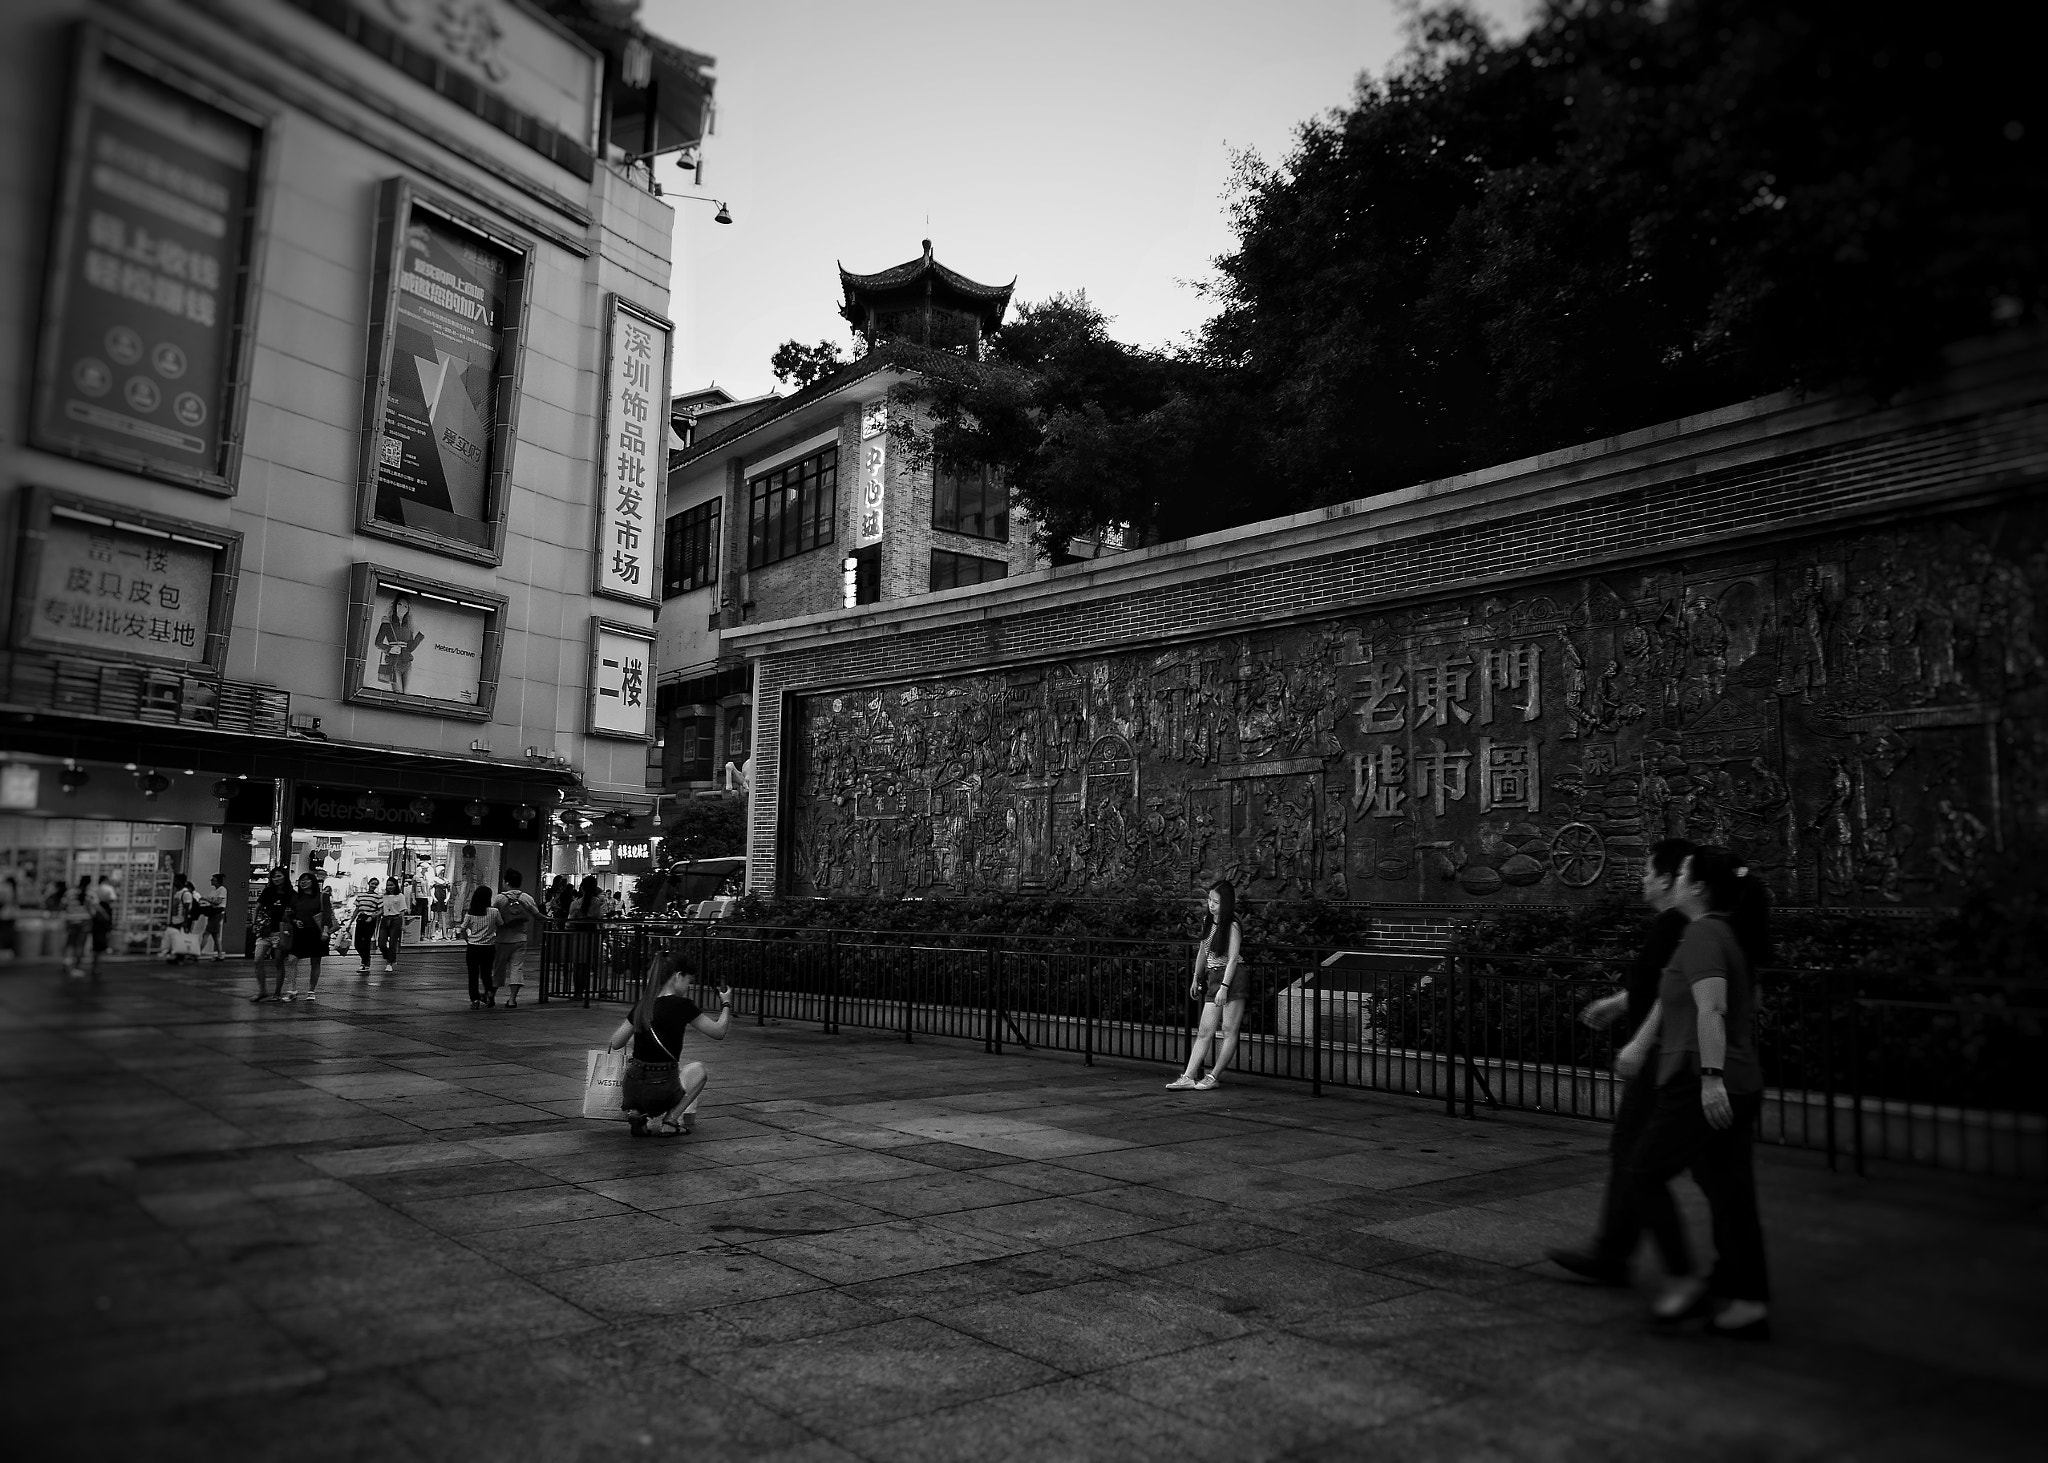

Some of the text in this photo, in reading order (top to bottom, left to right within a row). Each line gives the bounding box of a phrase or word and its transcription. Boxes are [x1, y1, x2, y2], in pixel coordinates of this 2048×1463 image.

[612, 323, 652, 586] 深圳饰品批发市场
[66, 567, 180, 610] 皮具皮包
[46, 601, 195, 647] 专业批发基地
[600, 656, 642, 708] 二楼
[1352, 643, 1545, 734] 老東門
